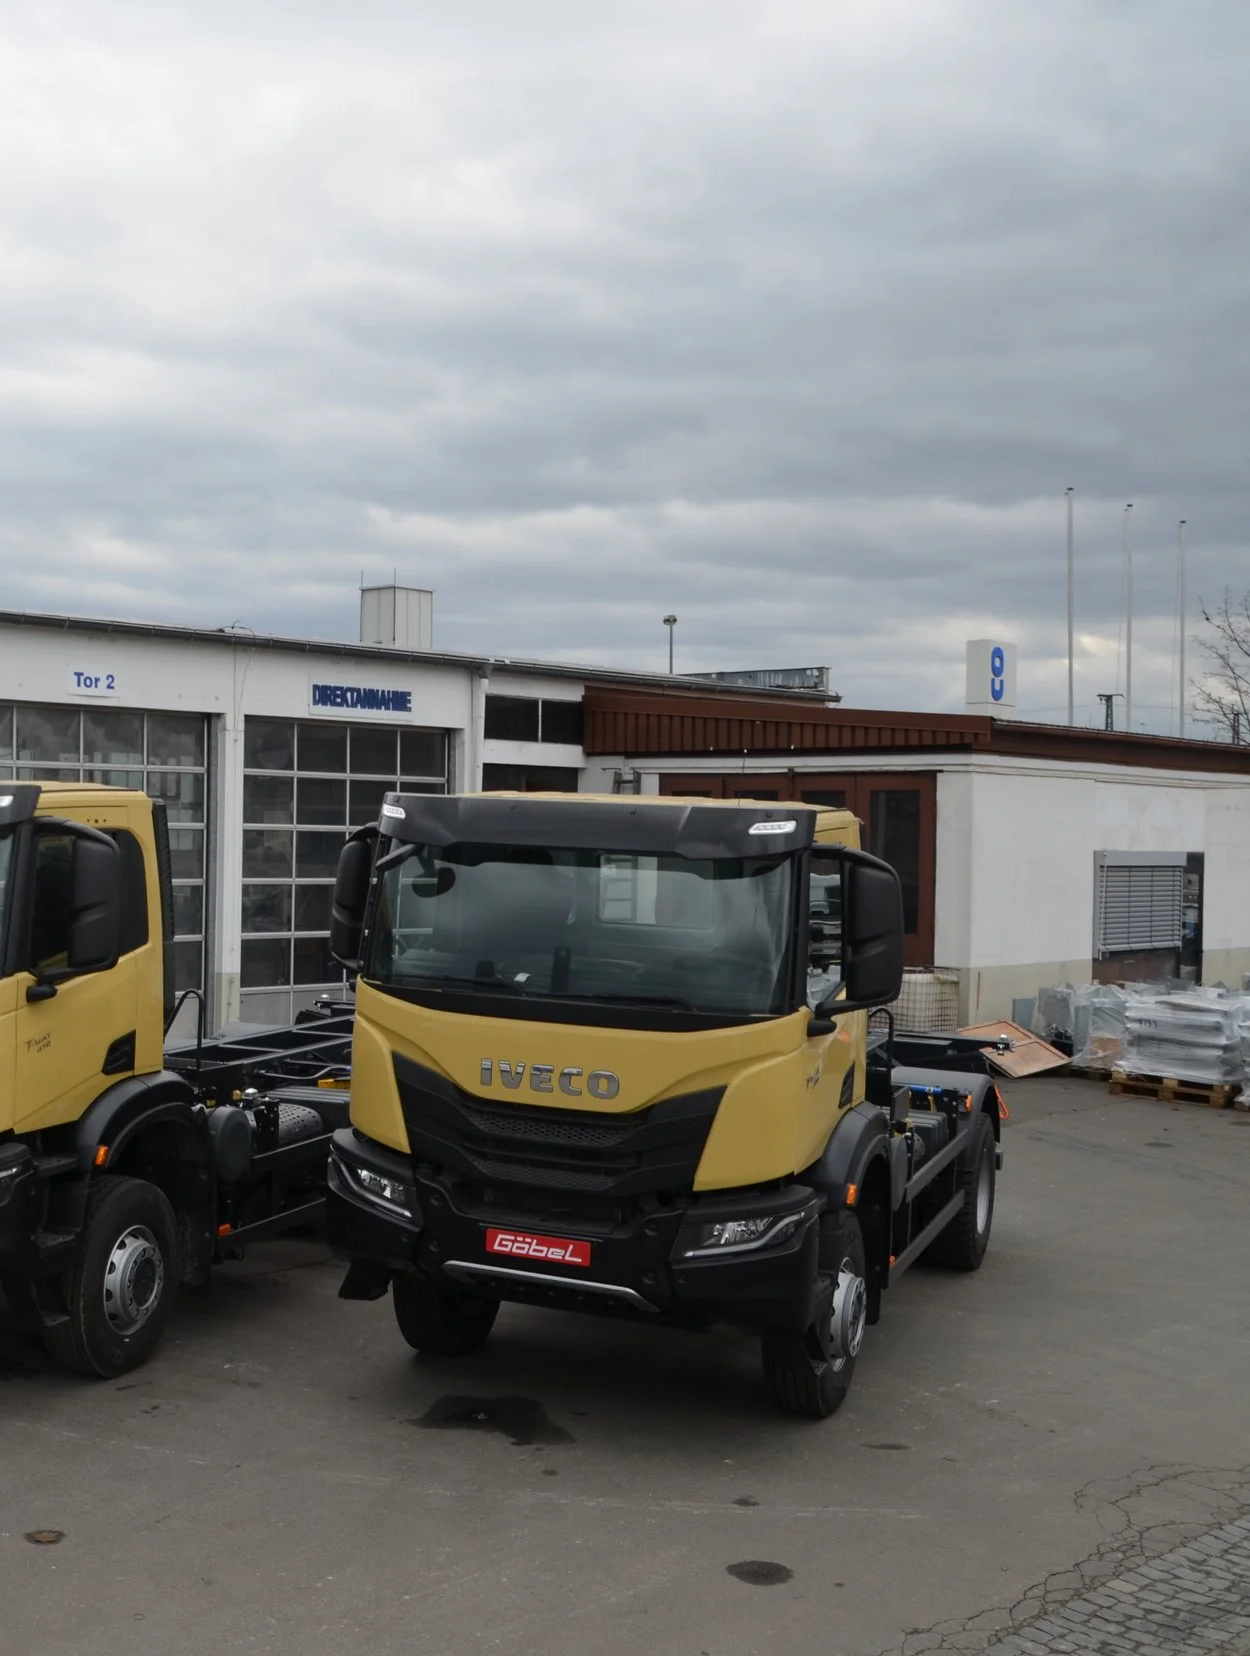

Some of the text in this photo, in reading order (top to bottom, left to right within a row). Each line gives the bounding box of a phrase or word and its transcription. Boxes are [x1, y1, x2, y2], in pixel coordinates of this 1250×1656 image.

[73, 671, 115, 690] Tor 2
[312, 684, 412, 713] DIREKTANNAHME
[480, 1058, 620, 1100] IVECO
